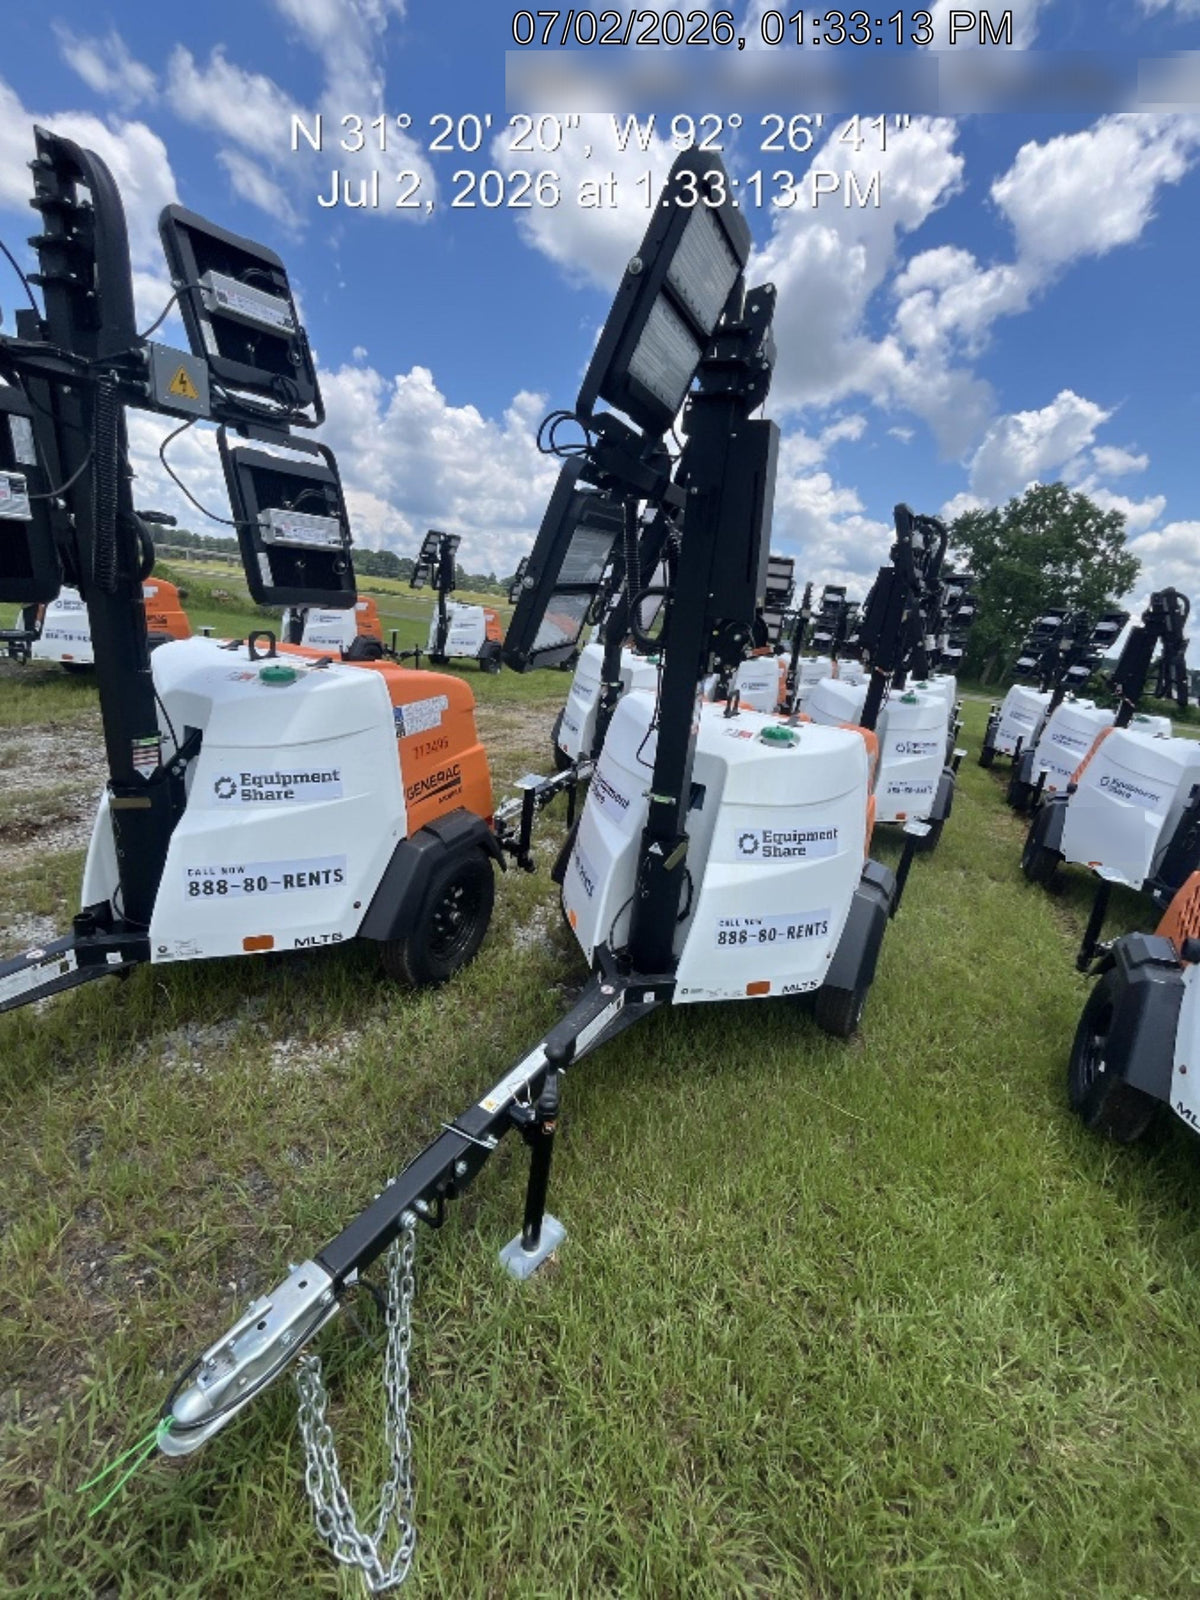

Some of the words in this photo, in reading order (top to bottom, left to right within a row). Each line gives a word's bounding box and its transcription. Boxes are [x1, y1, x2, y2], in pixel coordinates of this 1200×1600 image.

[240, 769, 341, 788] Equipment
[407, 764, 461, 801] GENERAC
[240, 788, 295, 801] Share
[762, 828, 838, 845] Equipment
[762, 845, 807, 858] Share
[188, 868, 216, 876] CALL
[221, 866, 245, 874] NOW
[188, 868, 344, 897] 888-80-RENTS
[717, 920, 828, 945] 888-80-RENTS
